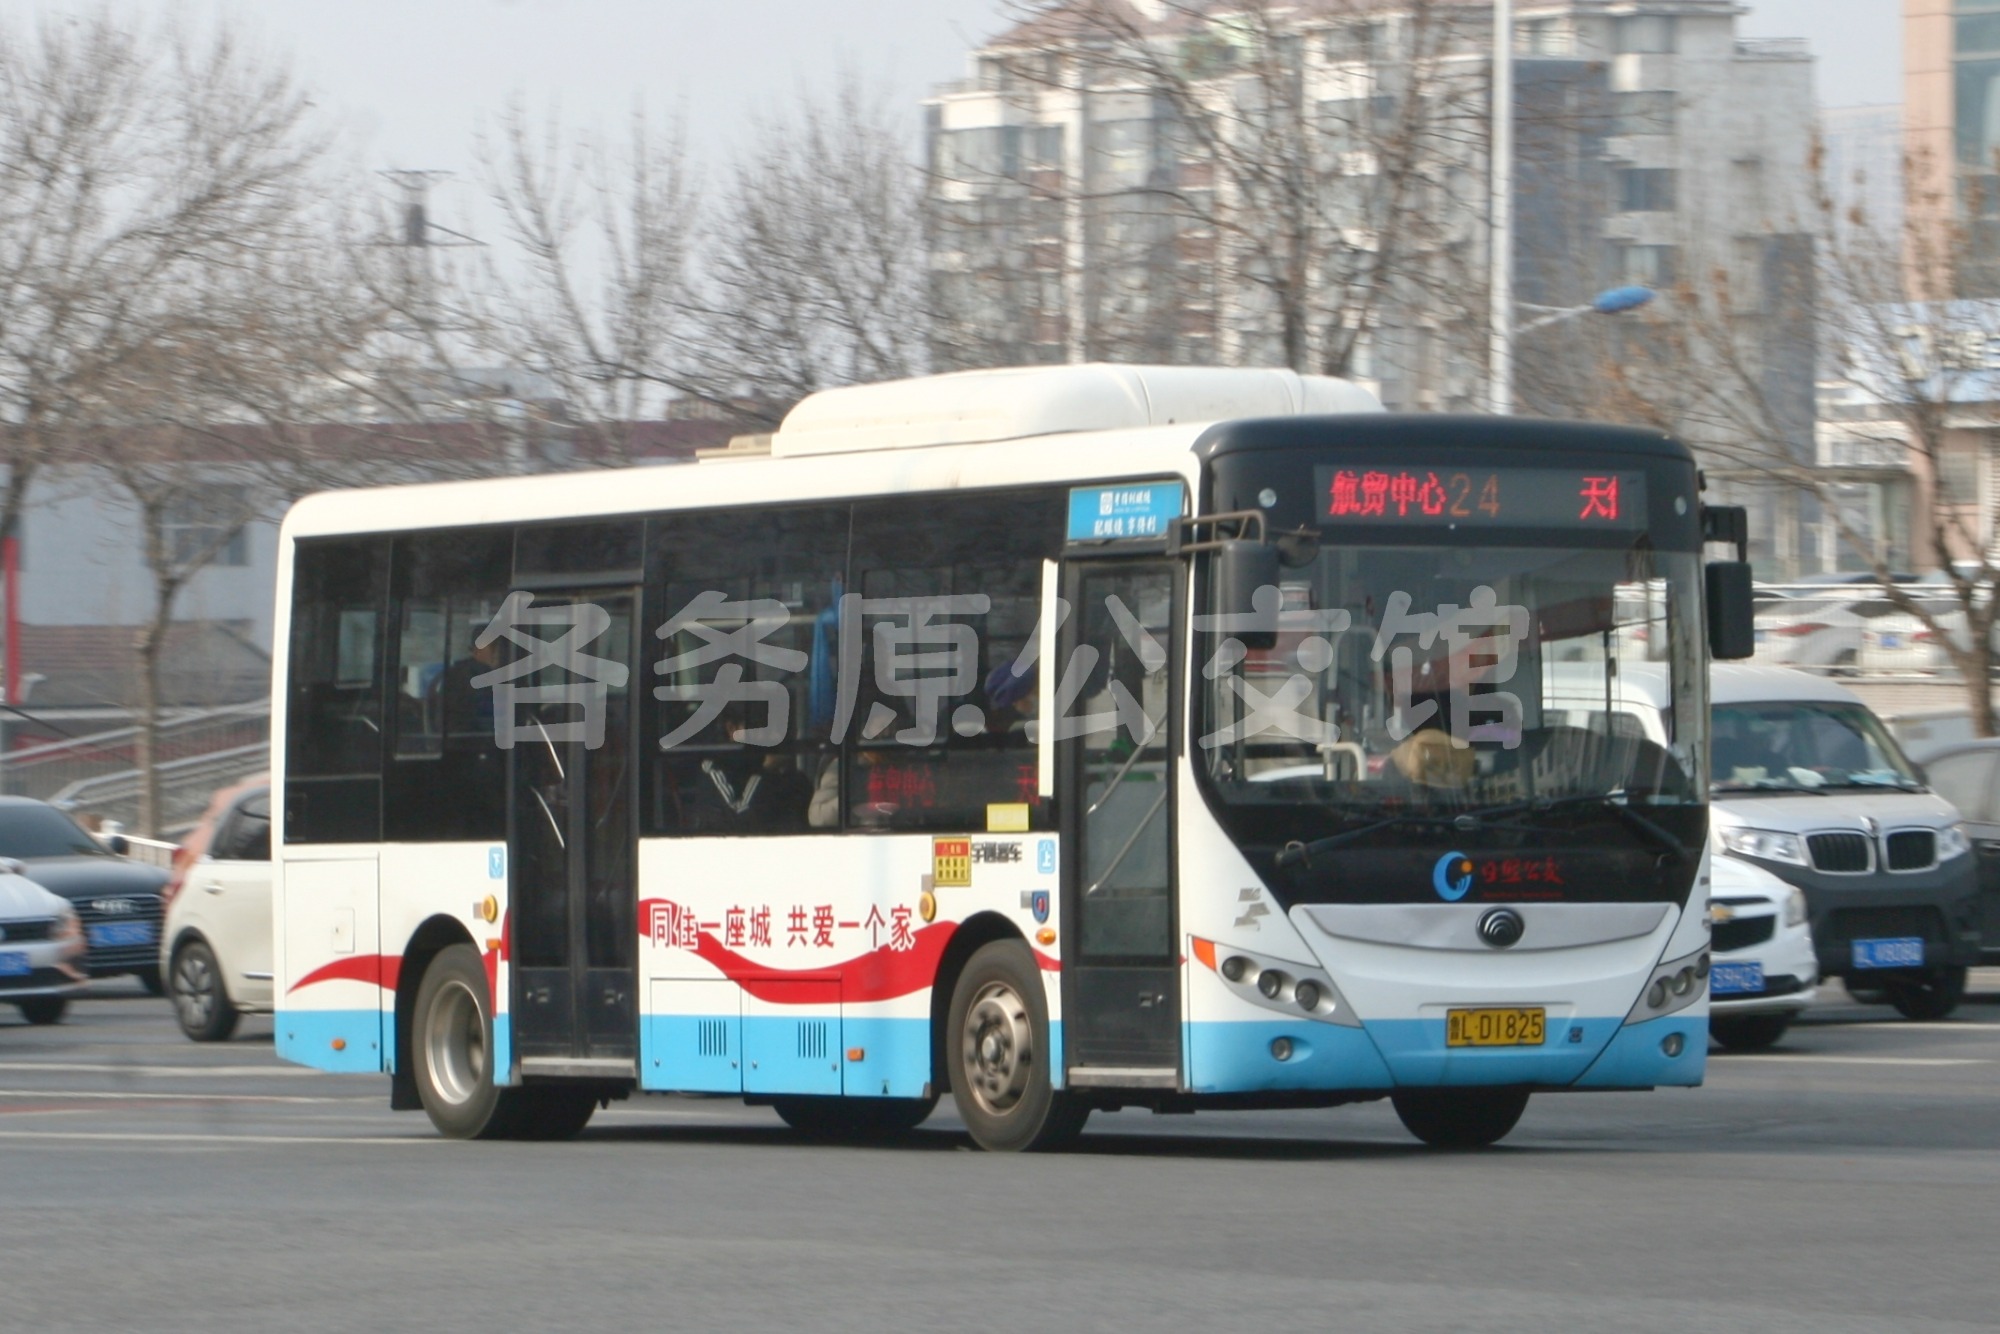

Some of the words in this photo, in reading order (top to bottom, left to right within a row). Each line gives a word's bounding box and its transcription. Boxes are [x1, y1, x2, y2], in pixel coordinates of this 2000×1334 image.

[1329, 469, 1447, 517] 航贸中心
[1450, 472, 1499, 518] 24
[651, 903, 772, 949] 同住一座城
[786, 903, 914, 950] 共爱一个家
